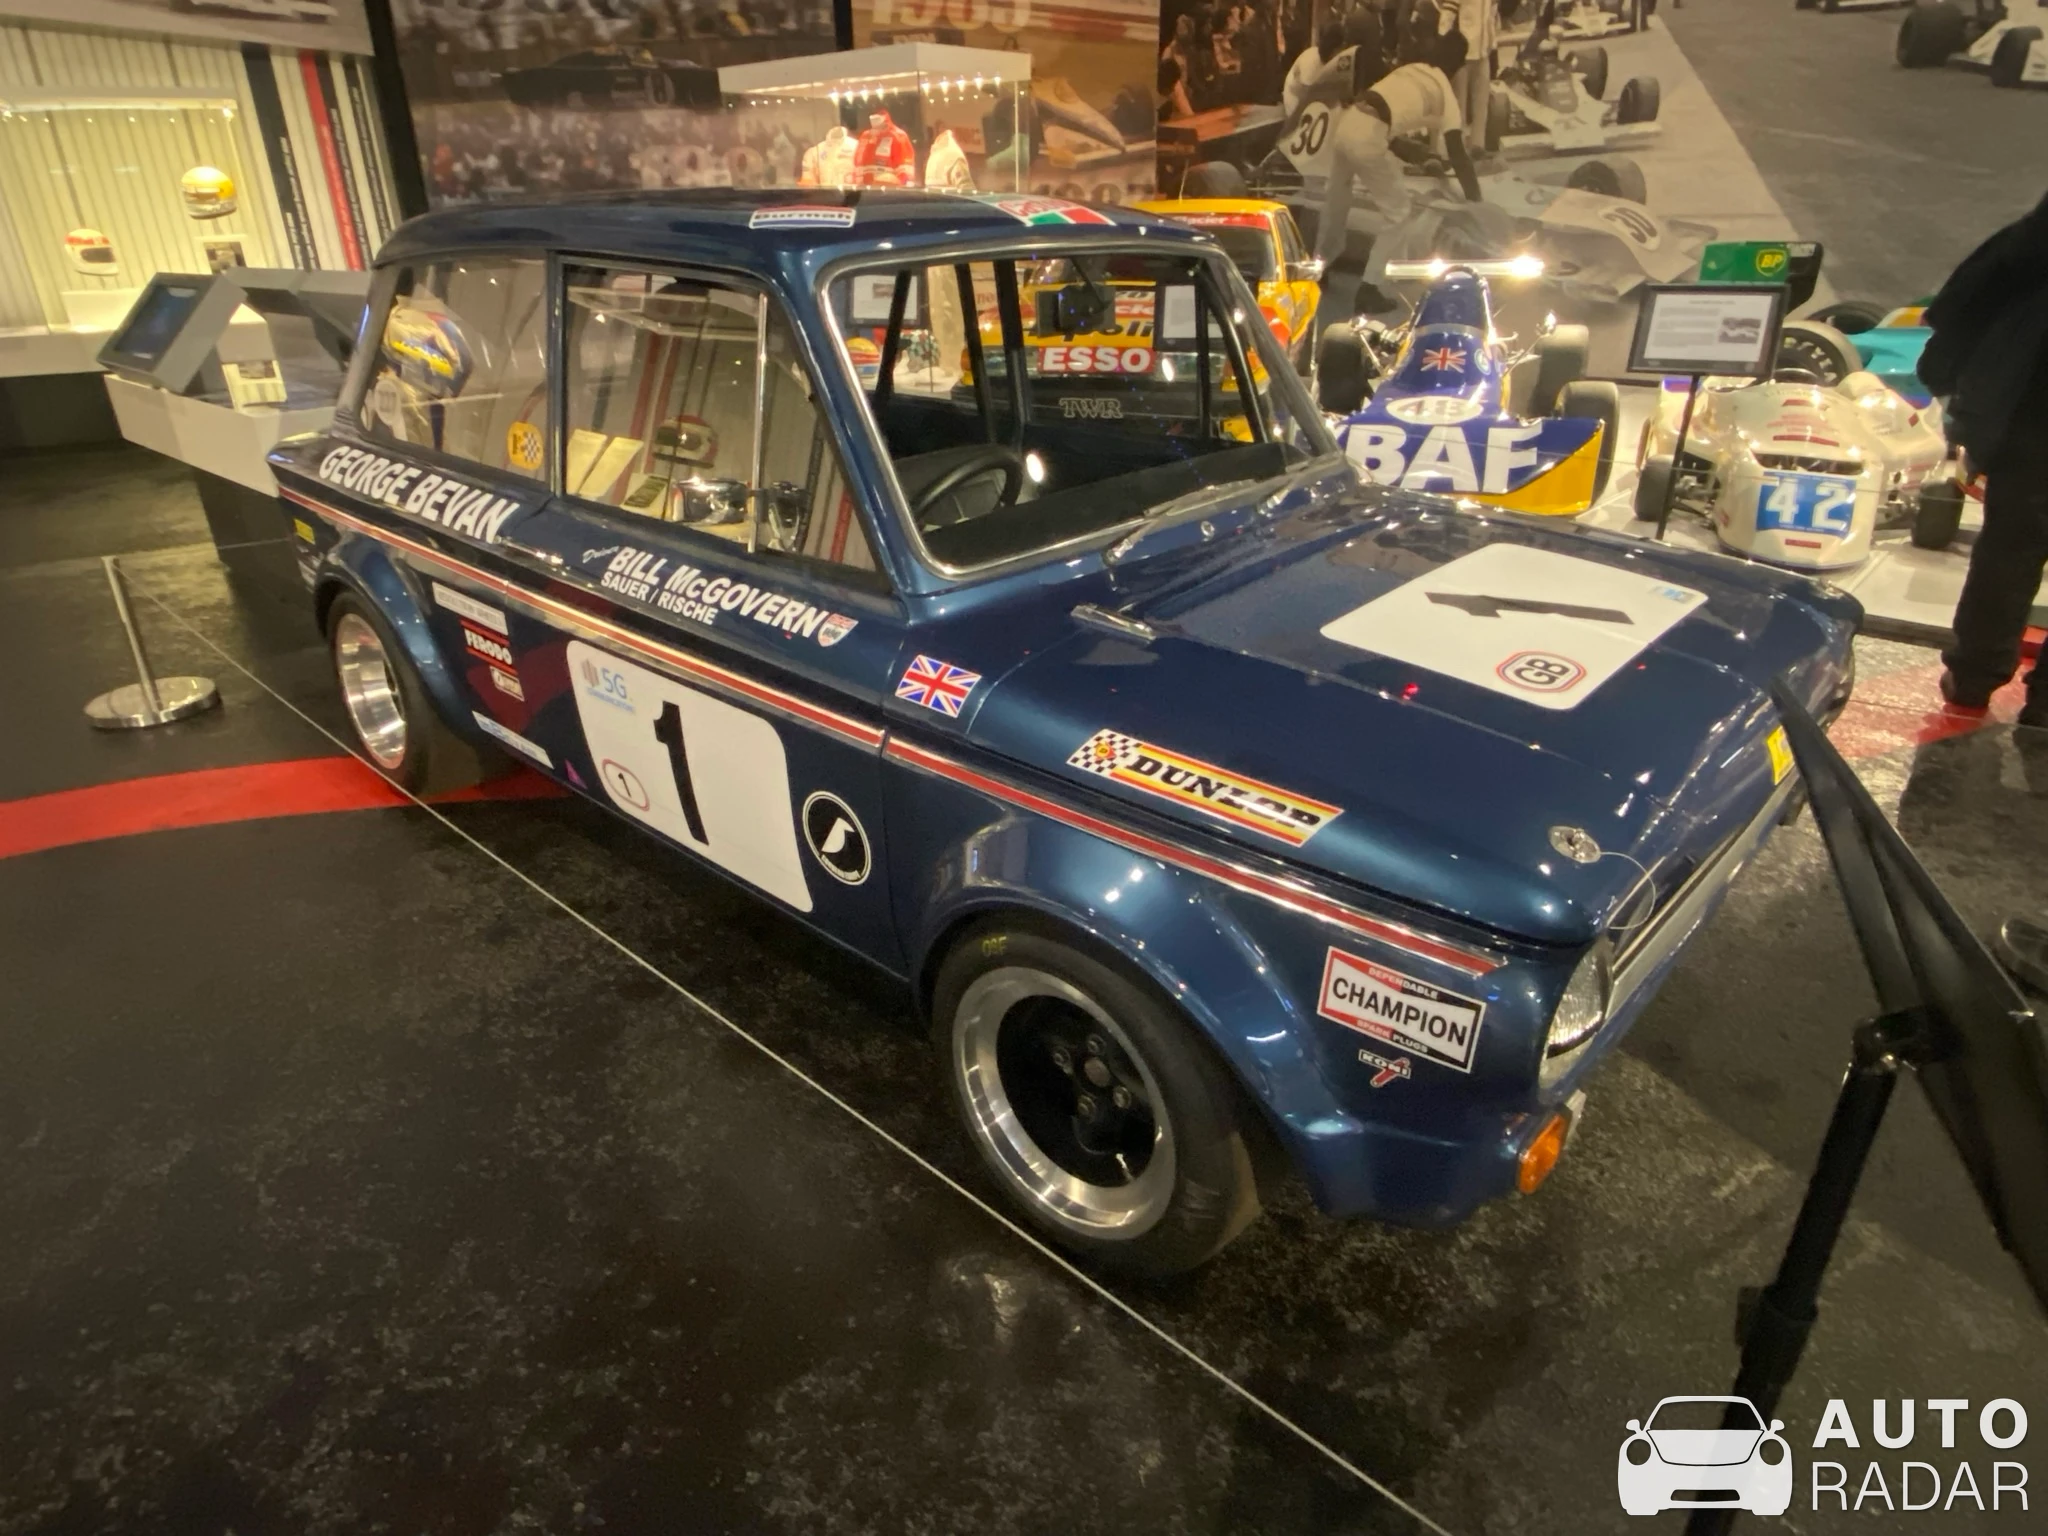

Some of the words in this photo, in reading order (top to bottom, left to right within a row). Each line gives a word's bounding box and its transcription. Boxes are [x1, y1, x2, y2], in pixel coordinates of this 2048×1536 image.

[1290, 112, 1329, 156] 30
[1604, 207, 1658, 244] 30
[1760, 253, 1784, 268] BP
[1043, 347, 1151, 373] ESSO
[1059, 397, 1123, 419] TWR
[318, 445, 421, 505] GEORGE
[405, 473, 520, 544] BEVAN
[1765, 478, 1848, 530] 42
[600, 570, 650, 603] SAUER
[657, 590, 719, 625] RISCHE
[608, 546, 668, 584] BILL
[664, 564, 829, 638] McGOVERN
[1424, 592, 1635, 625] 1
[464, 628, 513, 665] FERODO
[1514, 657, 1570, 686] GB
[617, 772, 632, 798] 1
[653, 700, 709, 846] 1
[1125, 754, 1322, 829] DUNLOP
[1368, 966, 1439, 999] DEPENDABLE
[1332, 977, 1468, 1047] CHAMPION
[1356, 1019, 1391, 1039] SPARK
[1392, 1034, 1429, 1054] PLUGS
[1362, 1053, 1408, 1076] KONI
